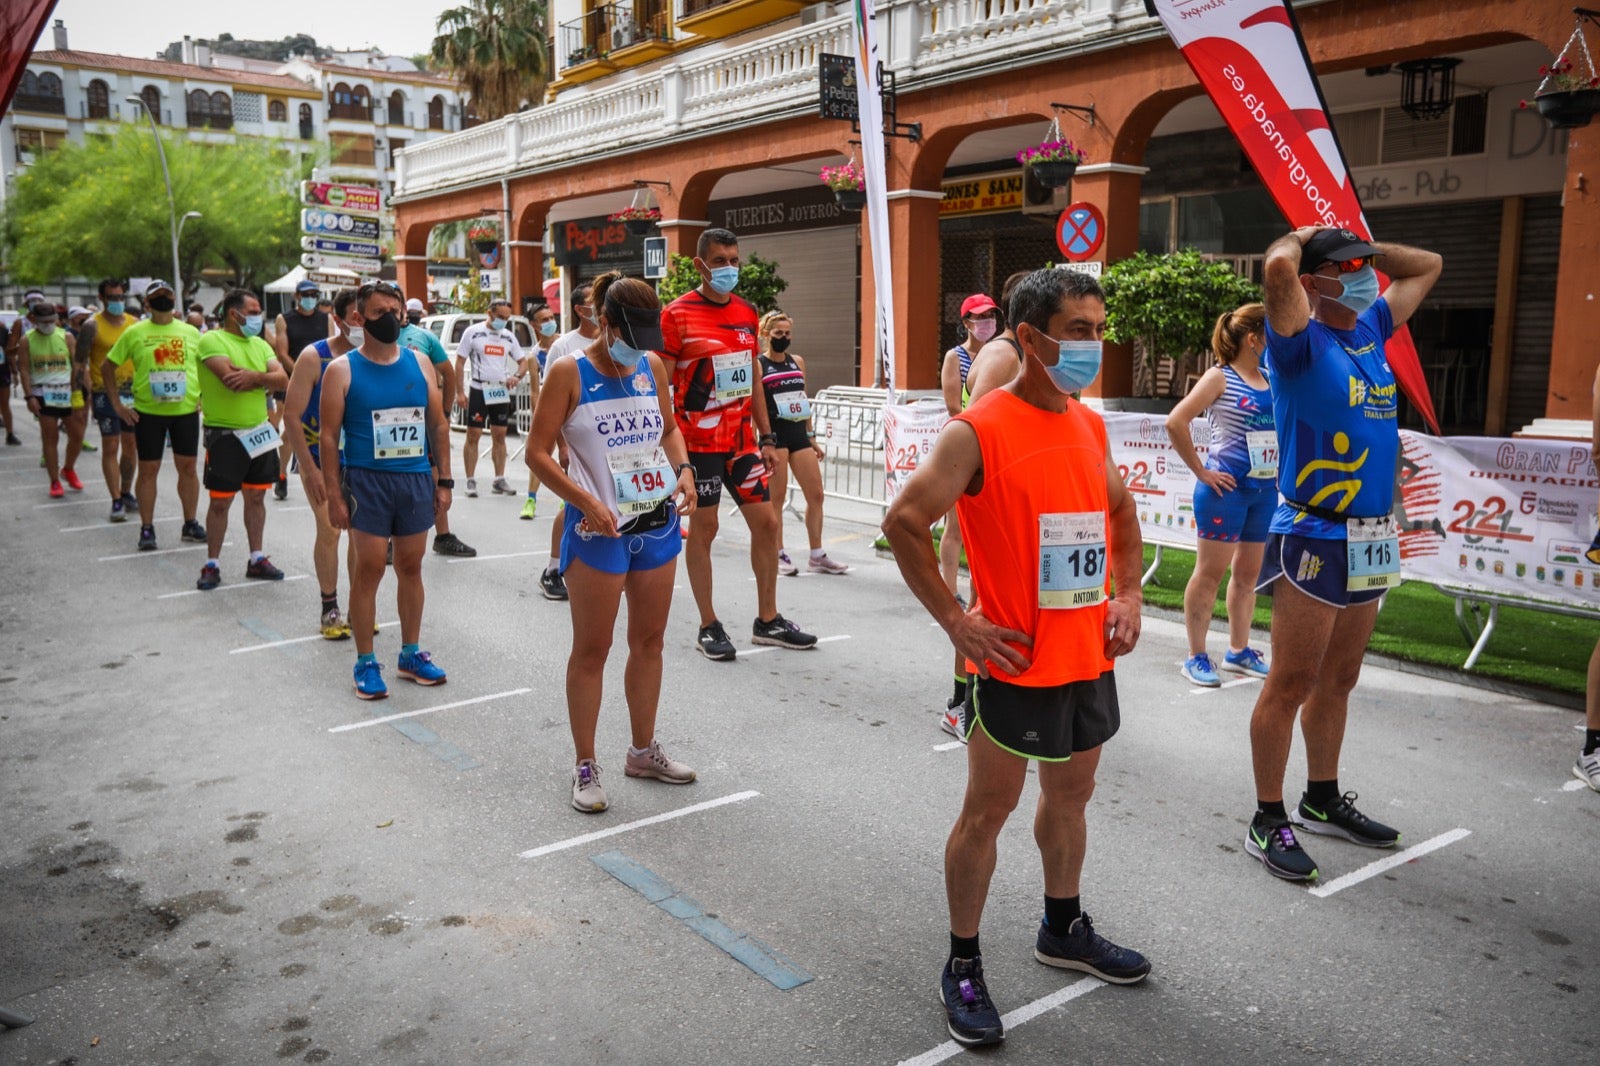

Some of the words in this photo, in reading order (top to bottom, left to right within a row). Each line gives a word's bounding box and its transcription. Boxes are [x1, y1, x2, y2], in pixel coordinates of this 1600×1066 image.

[1416, 168, 1461, 196] Pub
[981, 197, 996, 208] DE
[1000, 194, 1015, 205] LA
[725, 202, 784, 229] FUERTES
[789, 201, 841, 221] JOYEROS
[565, 222, 626, 261] Peques
[647, 249, 664, 267] TAXI
[732, 368, 746, 384] 40
[164, 382, 178, 393] 55
[790, 402, 802, 414] 66
[594, 413, 617, 421] CLUB
[597, 415, 662, 435] CAXAR
[249, 430, 271, 446] 1077
[390, 426, 418, 442] 172
[631, 470, 665, 493] 194
[632, 500, 653, 512] AFRICA
[1539, 498, 1579, 509] Diputación
[1546, 506, 1578, 517] Granada
[1068, 547, 1105, 578] 187
[1364, 543, 1391, 566] 116
[1043, 560, 1051, 583] MASTER
[1367, 576, 1388, 587] AMADOR
[1073, 590, 1099, 605] ANTONIO
